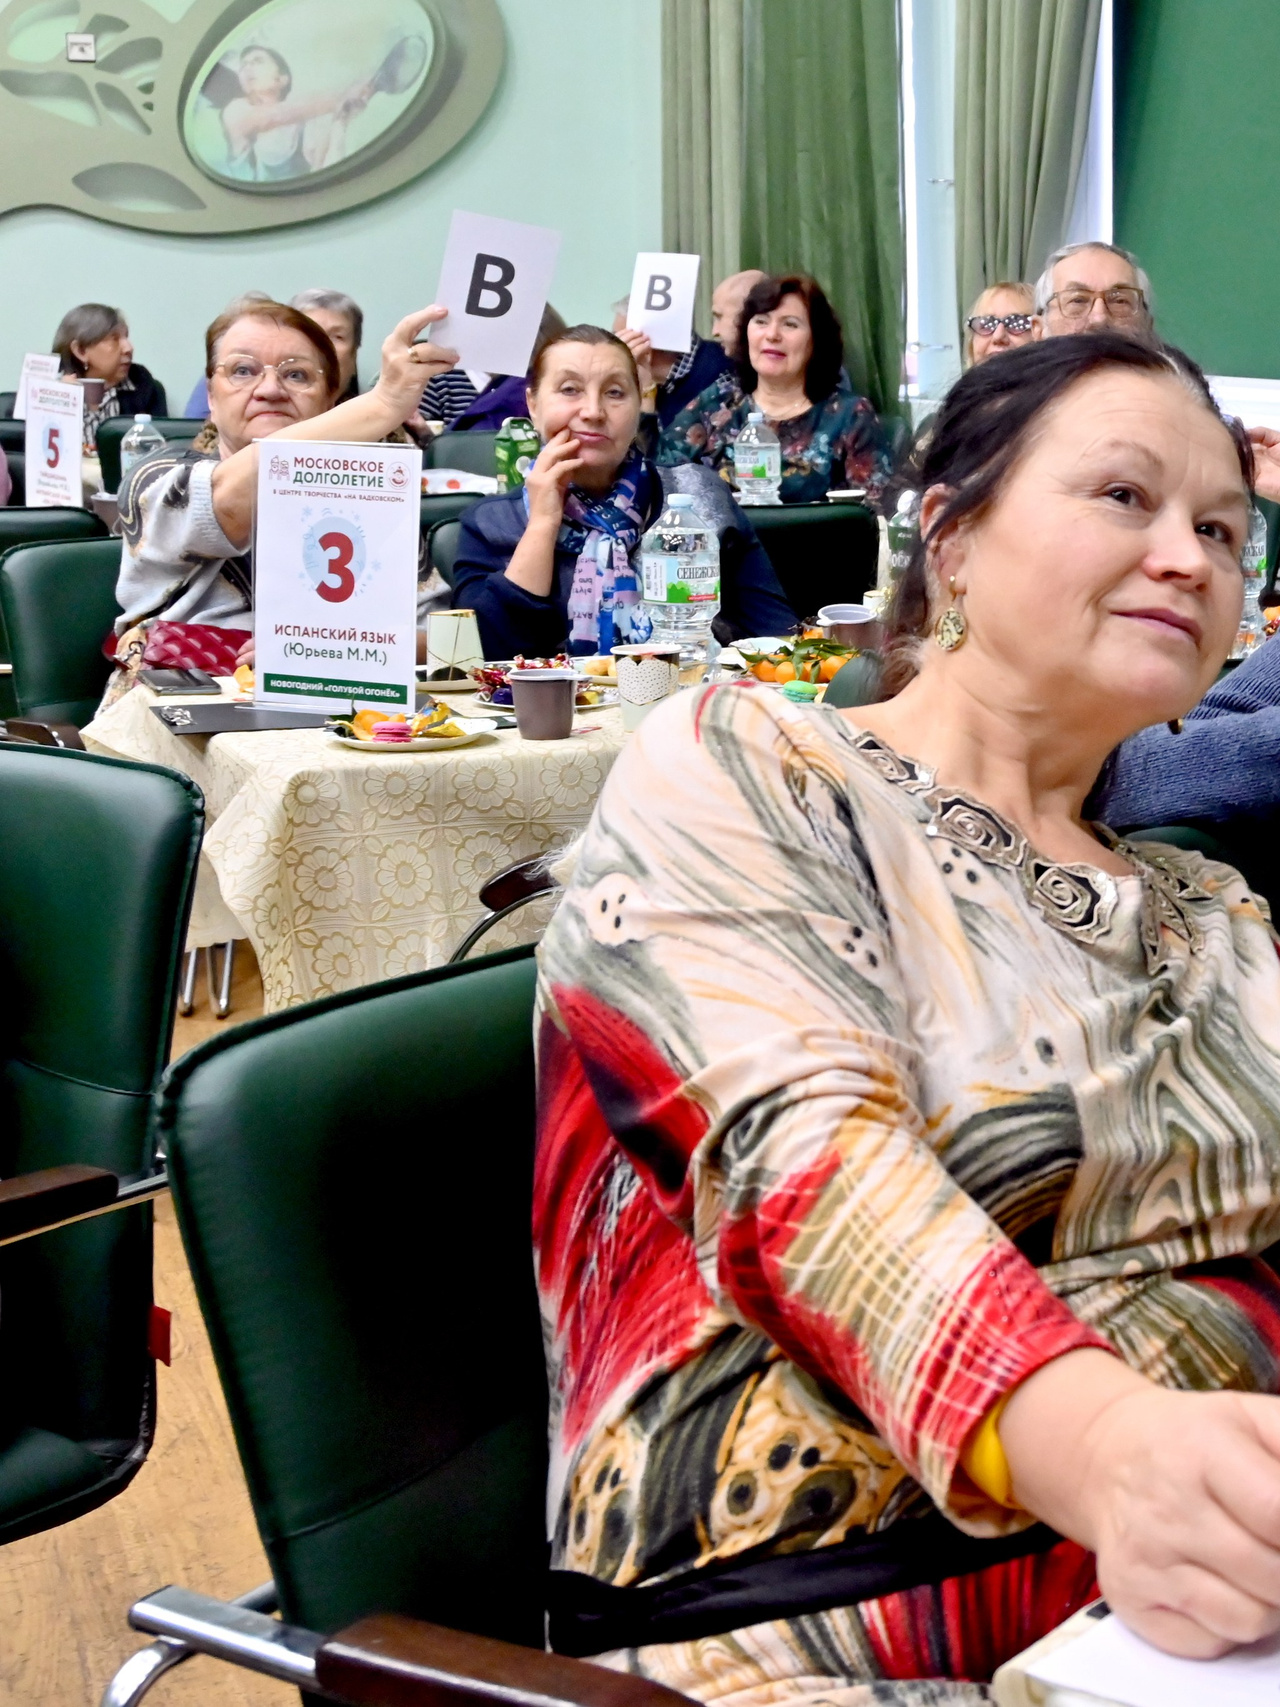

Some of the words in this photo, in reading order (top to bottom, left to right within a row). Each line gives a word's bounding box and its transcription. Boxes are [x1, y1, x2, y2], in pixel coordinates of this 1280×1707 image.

[464, 252, 517, 319] В
[643, 273, 673, 312] В
[46, 428, 61, 469] 5
[293, 456, 385, 473] МОСКОВСКОЕ
[292, 471, 385, 488] ДОЛГОЛЕТИЕ
[278, 489, 302, 497] ЦЕНТРЕ
[304, 491, 342, 499] ТВОРЧЕСТВА
[358, 494, 405, 503] ВАДКОВСКОМ»
[315, 531, 356, 604] 3
[274, 624, 357, 642] ИСПАНСКИЙ
[359, 632, 397, 645] ЯЗЫК
[283, 642, 343, 660] (Юрьева
[347, 647, 388, 666] М.М.)
[270, 679, 324, 692] НОВОГОДНИЙ
[324, 682, 364, 695] «ГОЛУБОЙ
[364, 687, 401, 698] ОГОНЁК»
